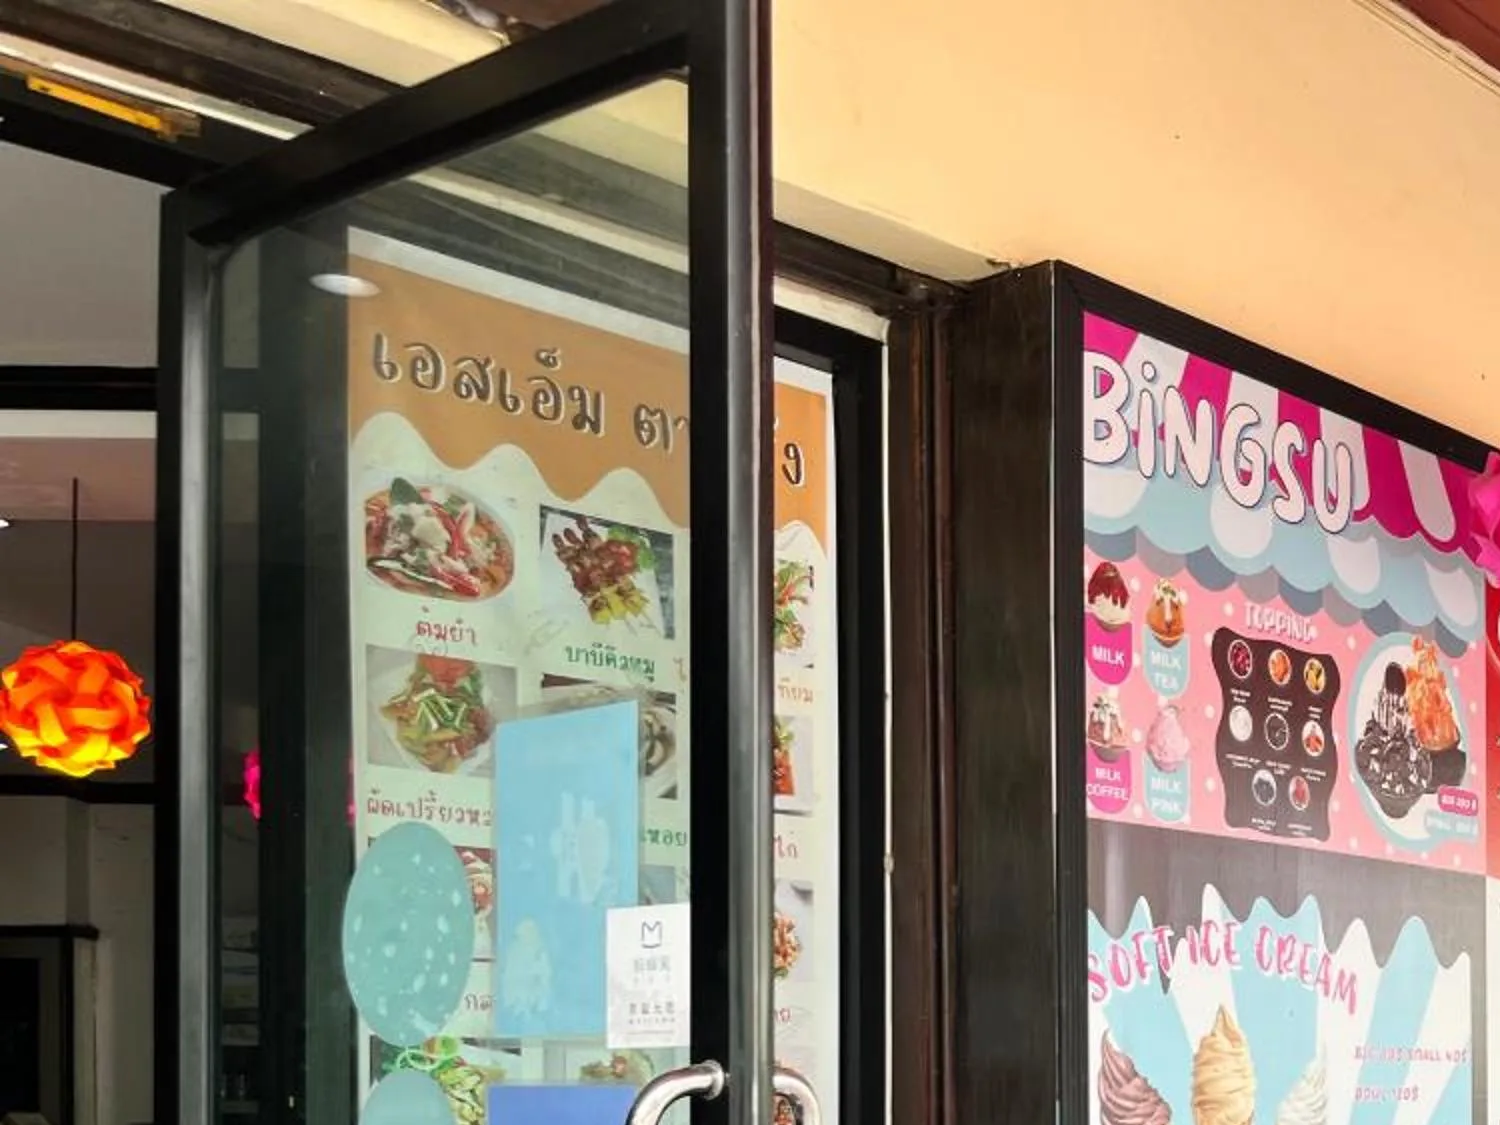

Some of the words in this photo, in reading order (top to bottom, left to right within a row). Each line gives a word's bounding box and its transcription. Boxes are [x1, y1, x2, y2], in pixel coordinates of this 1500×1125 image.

[1245, 601, 1313, 642] TOPPING
[1092, 645, 1125, 667] MILK
[1151, 651, 1182, 670] MILK
[1155, 673, 1180, 691] TEA
[1095, 767, 1121, 782] MILK
[1151, 777, 1182, 794] MILK
[1088, 924, 1174, 1002] SOFT
[1188, 919, 1242, 969] ICE
[1254, 926, 1359, 1016] CREAM
